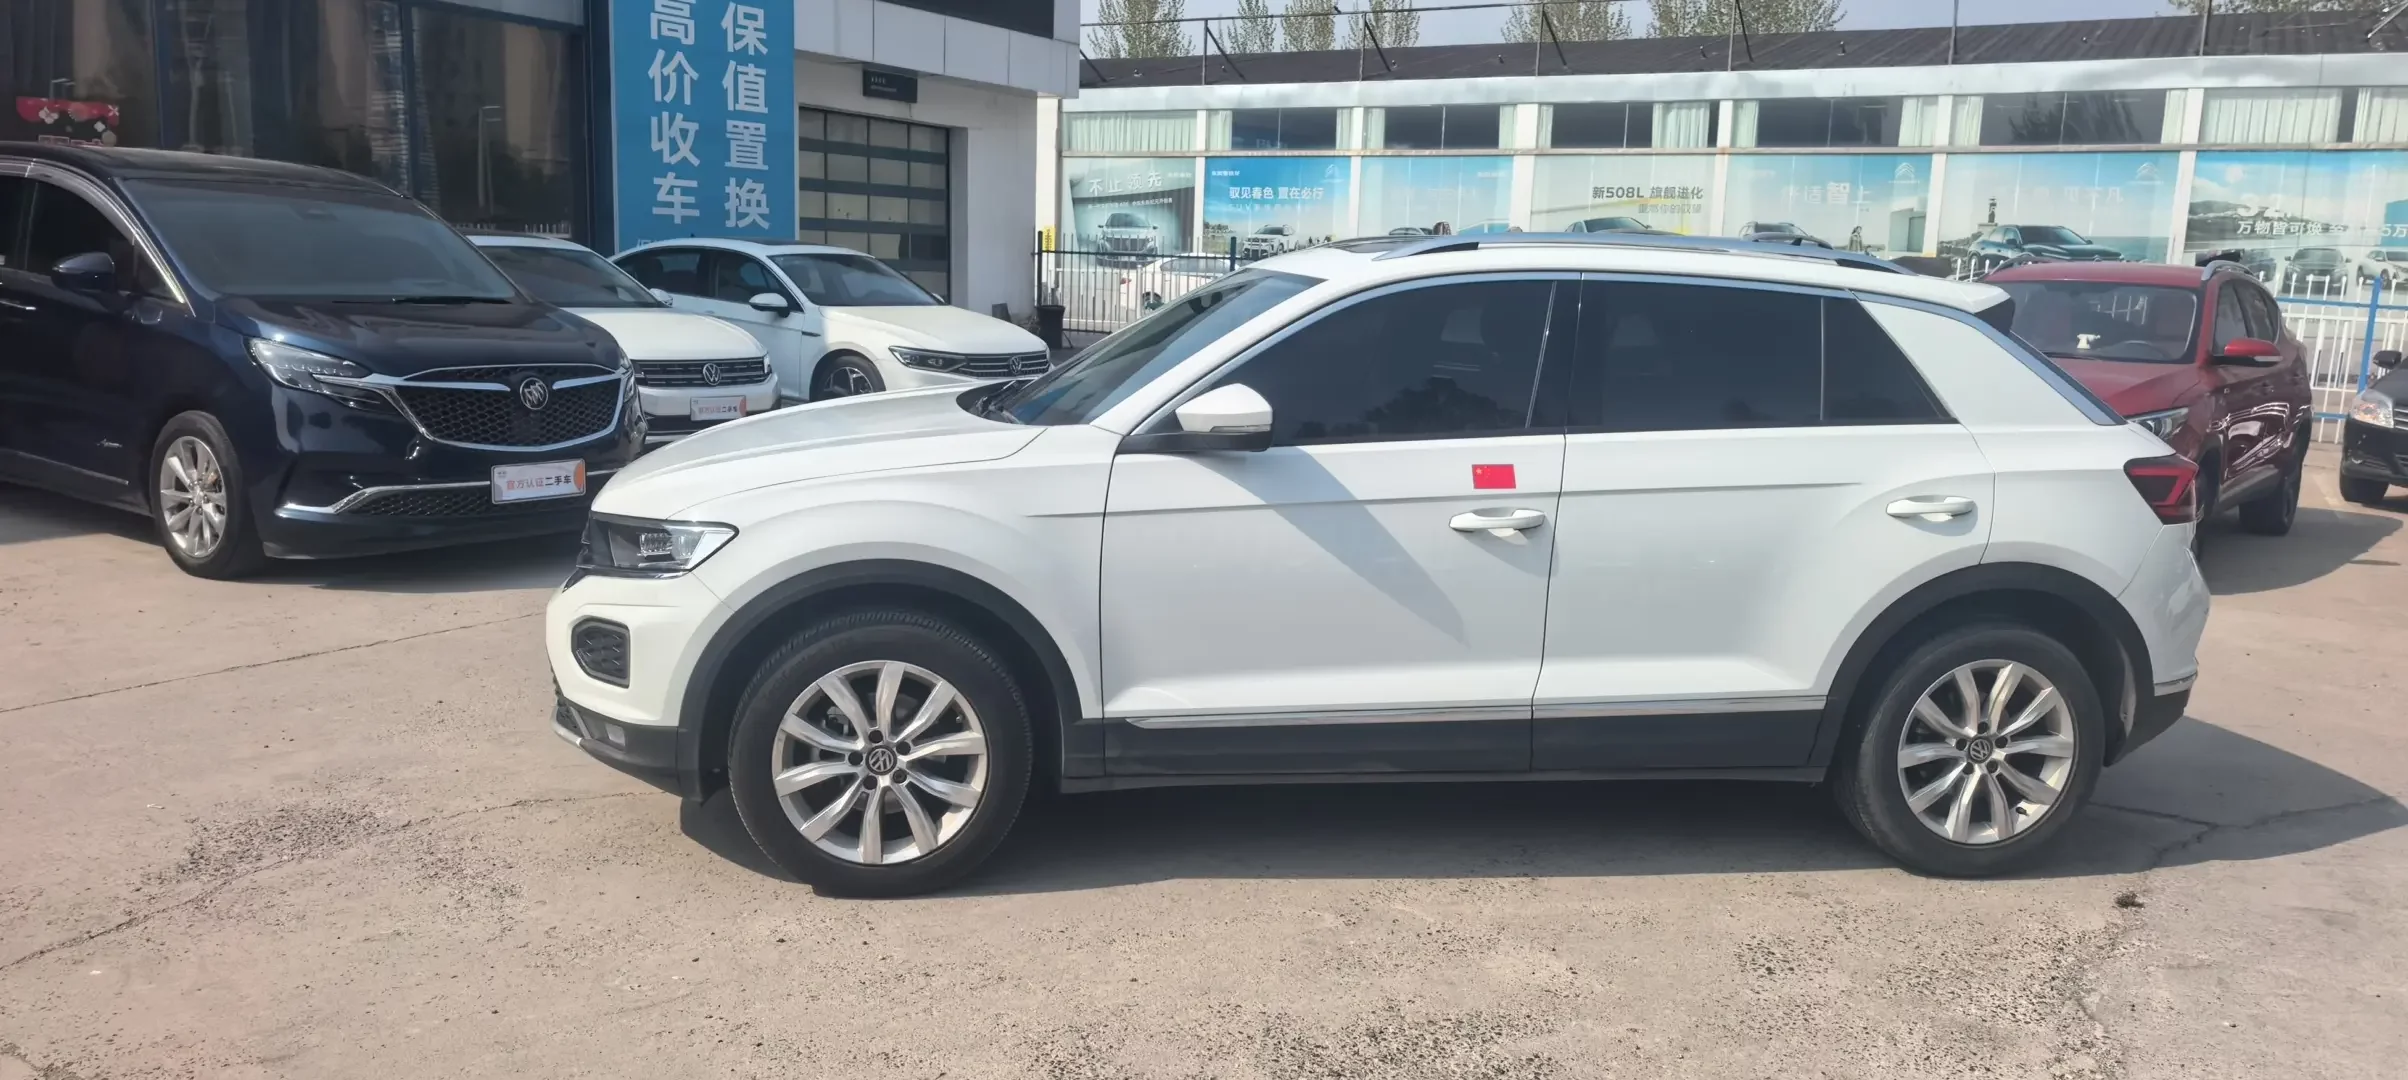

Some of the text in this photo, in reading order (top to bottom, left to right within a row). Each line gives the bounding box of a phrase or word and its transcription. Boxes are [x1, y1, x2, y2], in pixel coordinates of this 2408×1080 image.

[648, 0, 700, 224] 高价收车
[720, 1, 770, 229] 保值置换
[1592, 186, 1704, 199] 新508L 旗舰进化
[506, 475, 572, 491] 官方认证二手车
